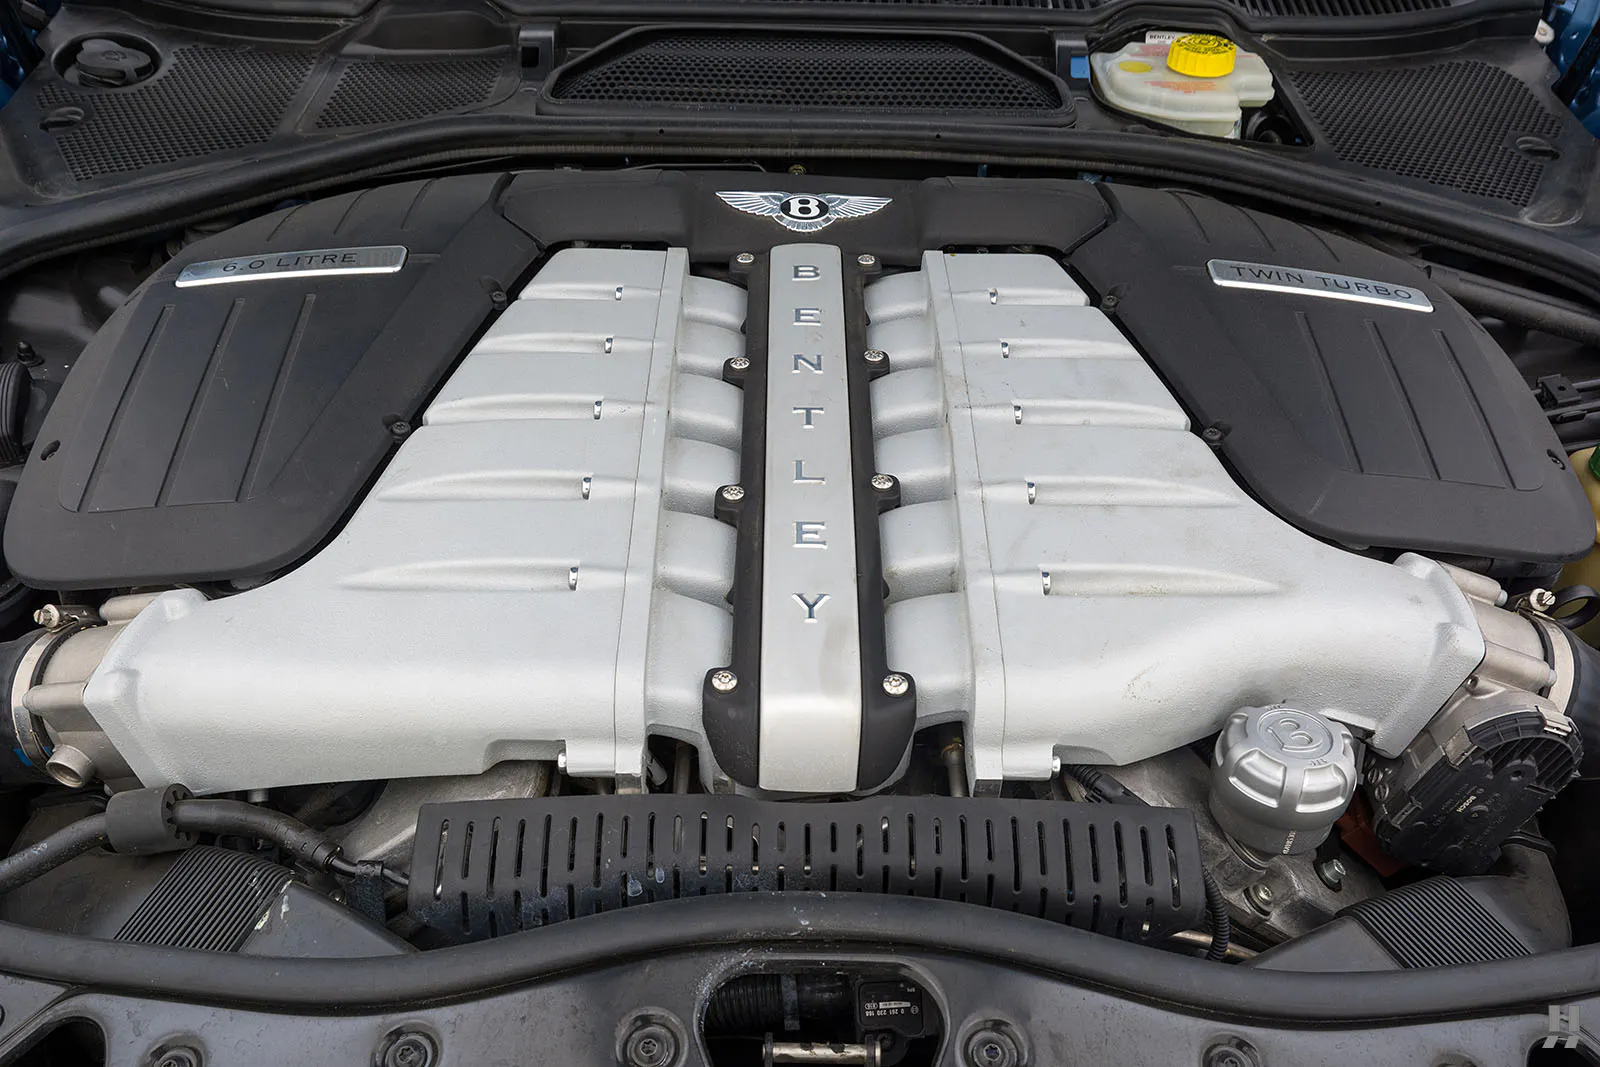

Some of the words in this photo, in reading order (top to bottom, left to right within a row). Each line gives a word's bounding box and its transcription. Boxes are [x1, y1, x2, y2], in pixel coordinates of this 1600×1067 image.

[788, 197, 821, 217] B
[222, 260, 265, 272] 6.0
[276, 252, 358, 268] LITRE
[1229, 265, 1304, 284] TWIN
[1315, 276, 1412, 300] TURBO
[792, 264, 831, 623] BENTLEY
